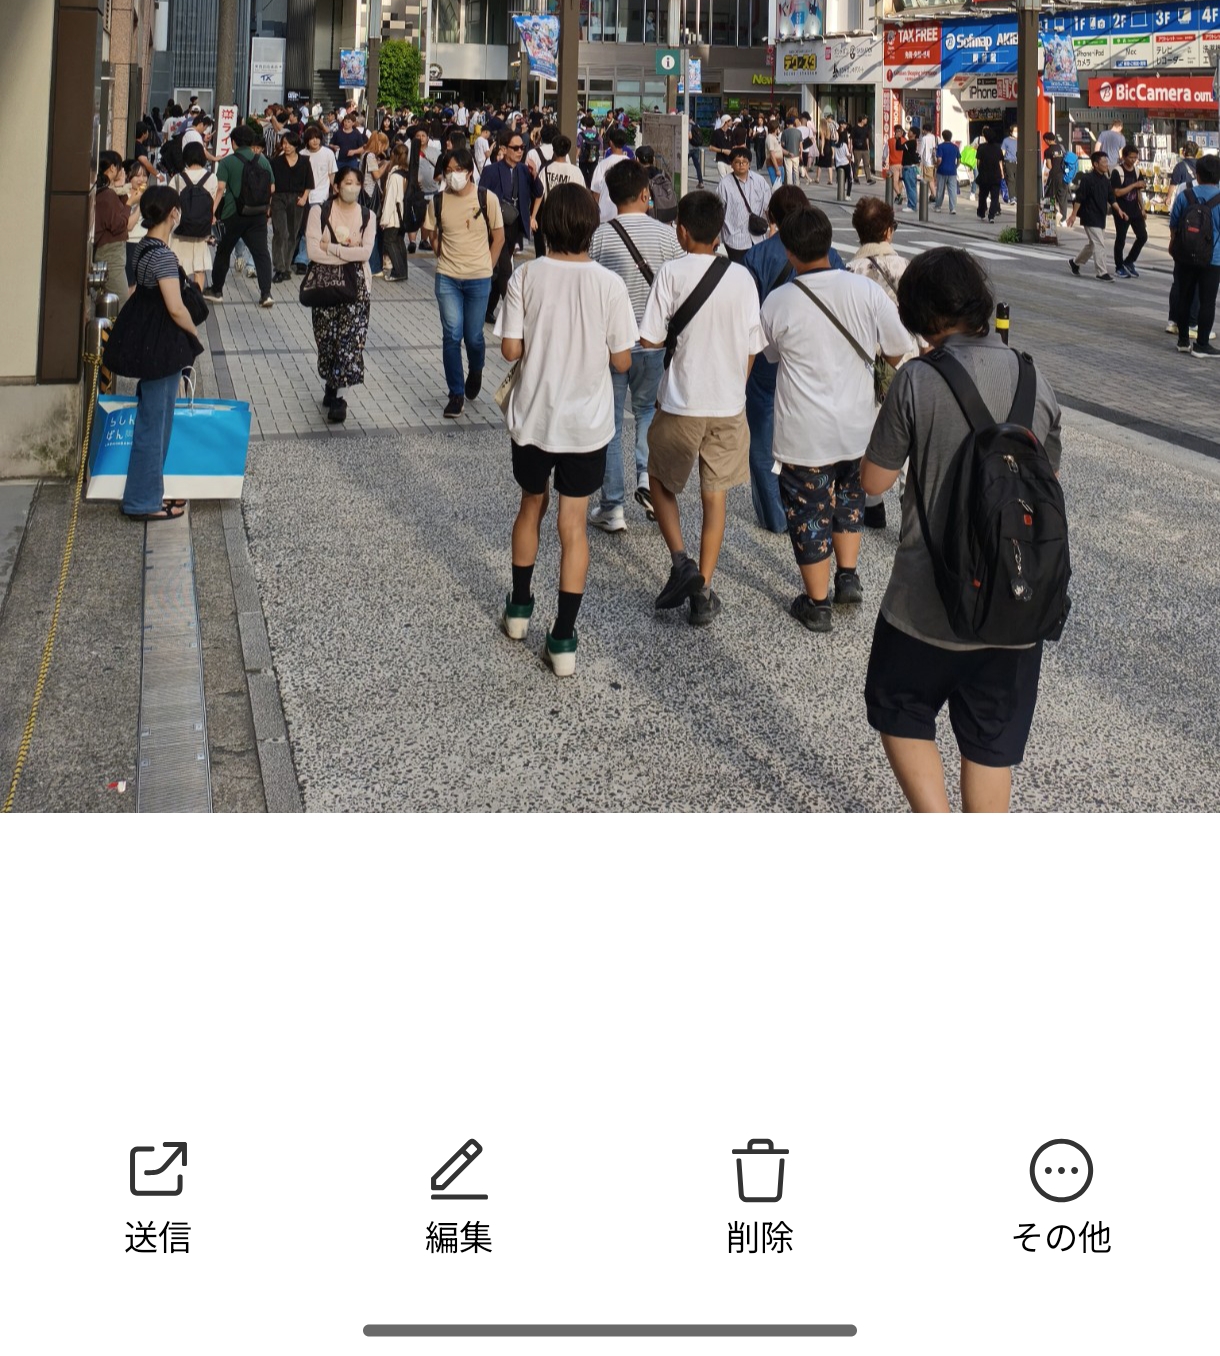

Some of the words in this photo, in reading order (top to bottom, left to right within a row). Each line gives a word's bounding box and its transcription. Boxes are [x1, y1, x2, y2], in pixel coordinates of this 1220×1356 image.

[1112, 12, 1127, 29] 2F
[1155, 9, 1171, 26] 3F
[1201, 5, 1219, 23] 4F
[898, 29, 915, 43] TAX
[915, 27, 939, 42] FREE
[956, 33, 993, 51] Sofmap
[969, 85, 997, 99] iPhone
[1116, 83, 1192, 101] BicCamera
